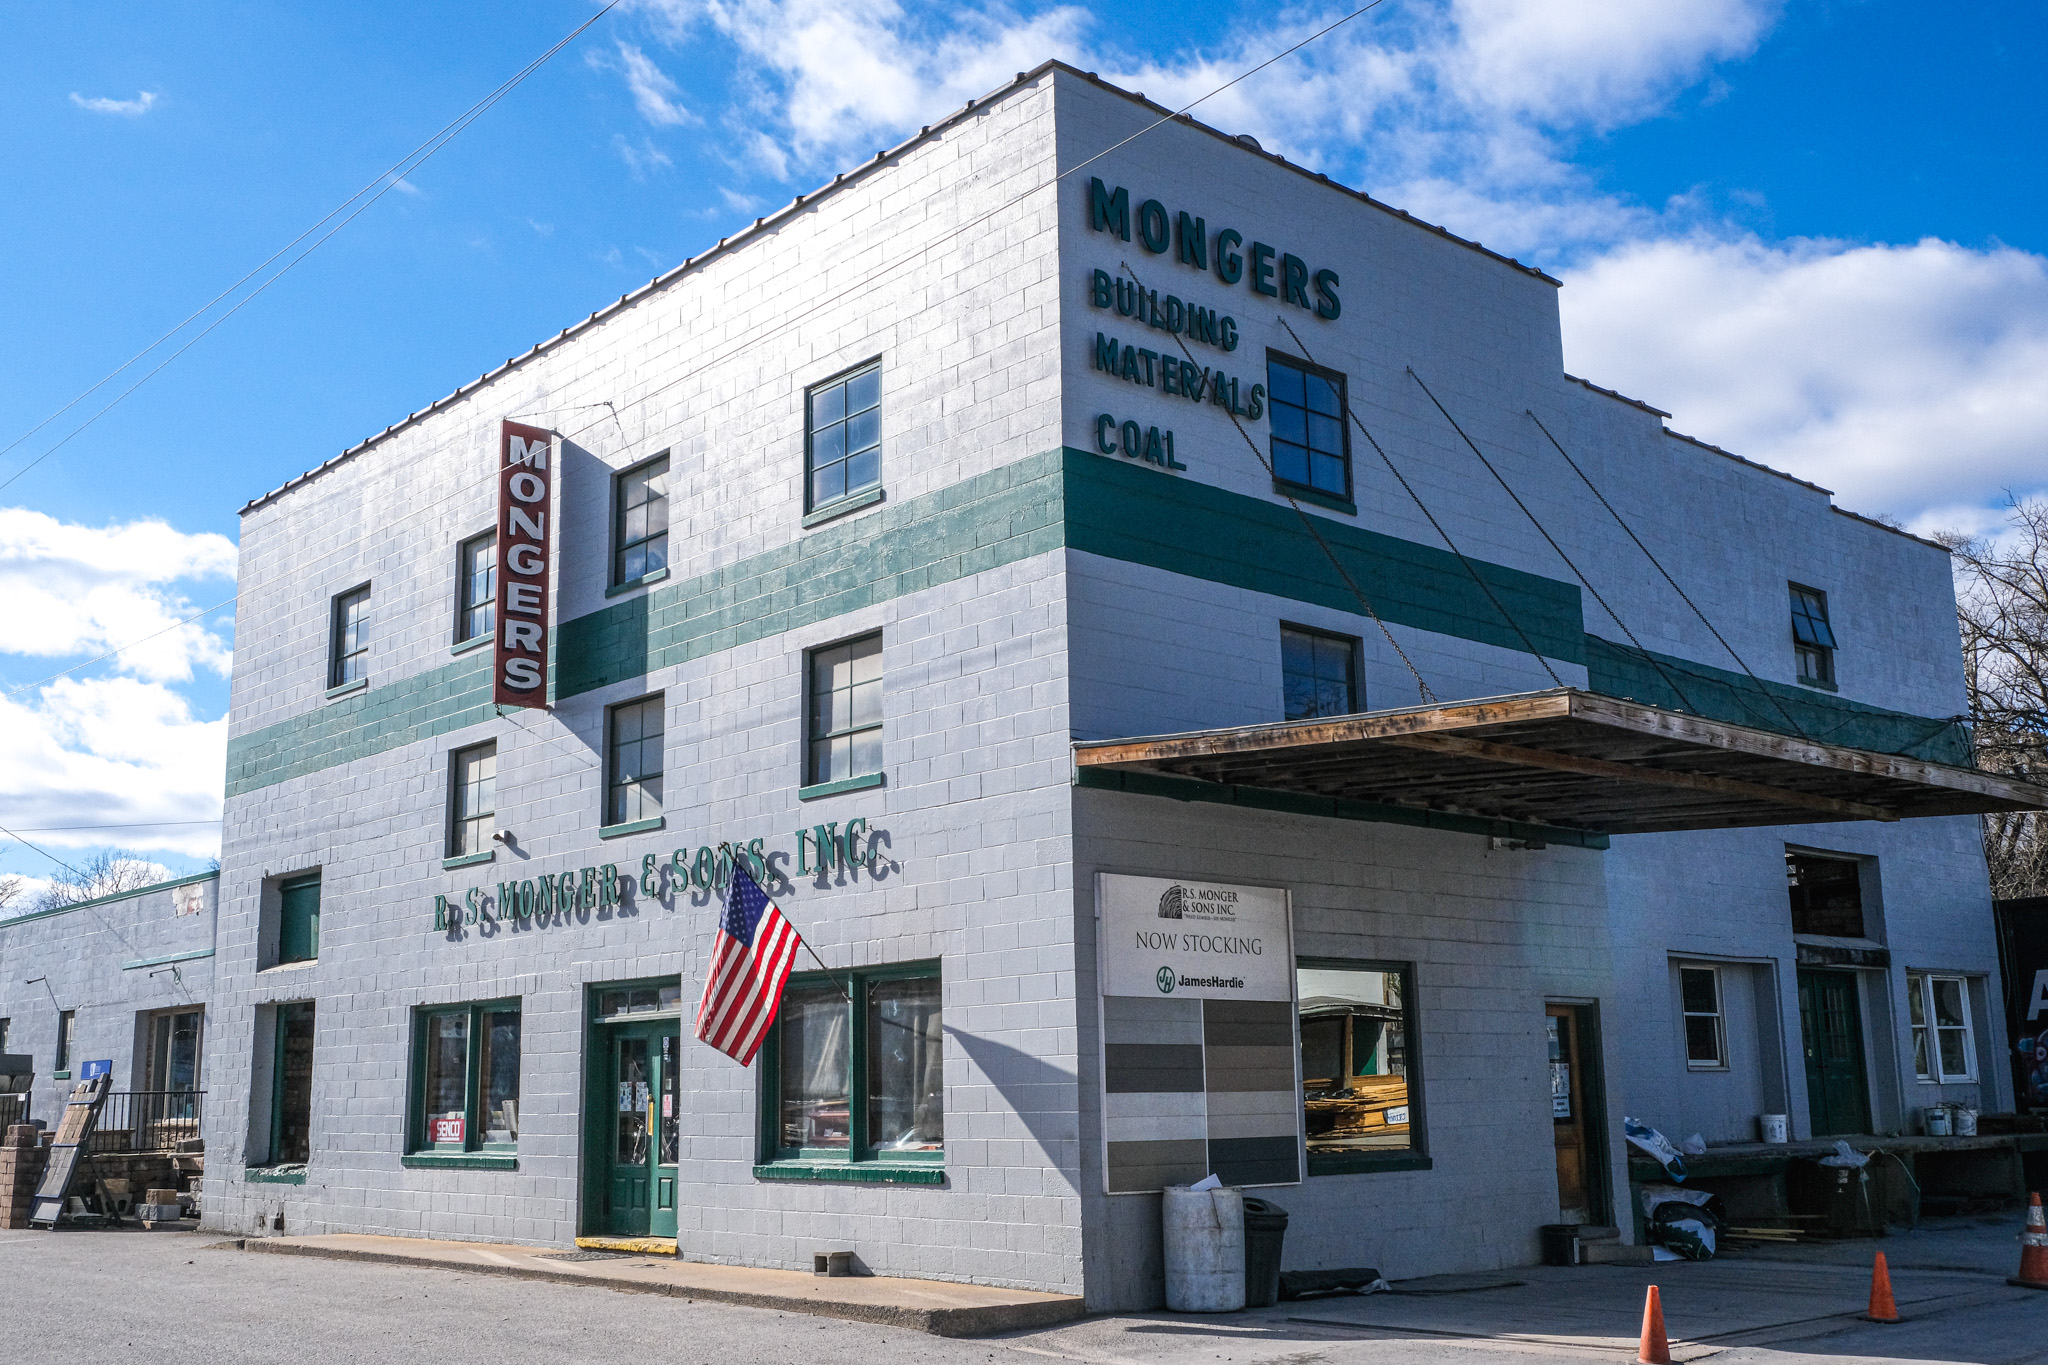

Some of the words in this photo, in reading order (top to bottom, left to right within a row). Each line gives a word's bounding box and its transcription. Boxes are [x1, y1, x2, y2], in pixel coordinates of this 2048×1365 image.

[1091, 176, 1341, 321] MONGERS
[1094, 268, 1239, 351] BUILDING
[1096, 332, 1265, 421] MATERIALS
[1097, 413, 1187, 472] COAL
[504, 434, 547, 689] MONGERS
[465, 887, 486, 926] S.
[497, 863, 621, 921] MONGER
[795, 817, 877, 877] INC.
[1199, 889, 1239, 903] MONGER
[1182, 900, 1189, 912] &
[1191, 902, 1215, 914] SONS
[1217, 904, 1236, 916] INC.
[1136, 931, 1177, 950] NOW
[1183, 934, 1262, 955] STOCKING
[1178, 975, 1244, 988] JamesHardie
[437, 1121, 461, 1136] SENCO
